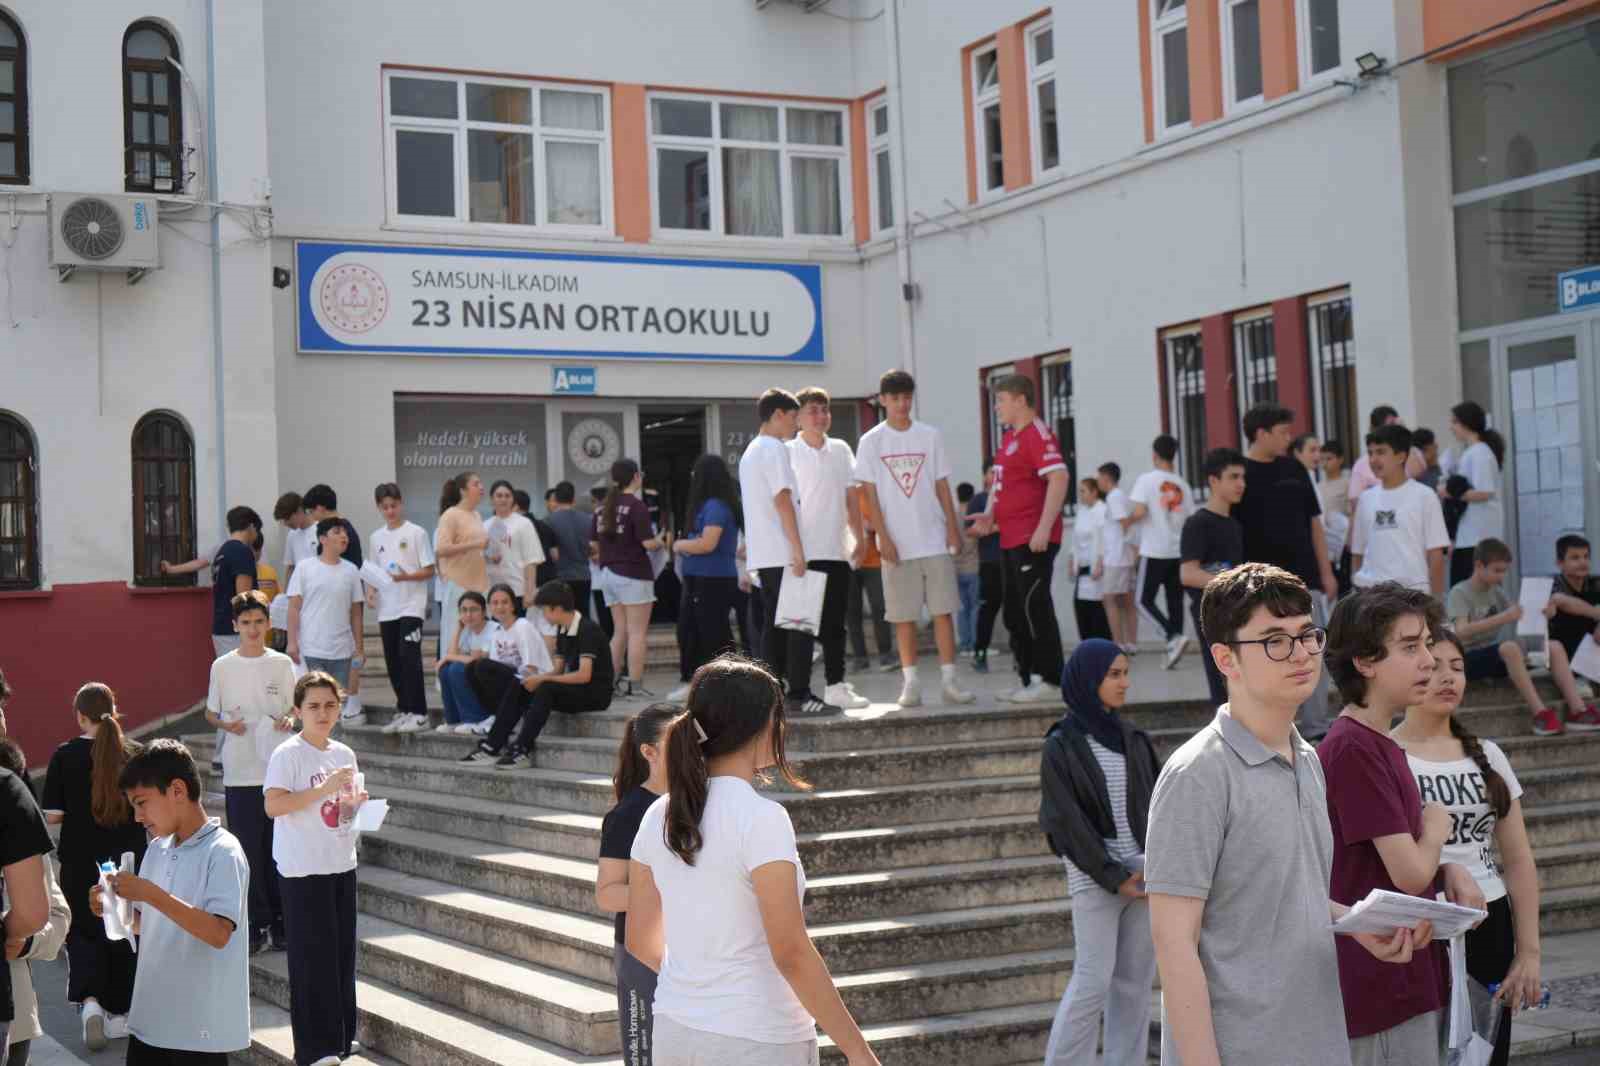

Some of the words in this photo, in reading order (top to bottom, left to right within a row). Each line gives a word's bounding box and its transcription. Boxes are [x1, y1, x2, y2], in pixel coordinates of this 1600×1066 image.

[412, 269, 579, 293] SAMSUN-İLKADIM
[1563, 278, 1578, 306] B
[1578, 280, 1600, 297] BLO
[411, 299, 451, 327] 23
[462, 293, 565, 330] NİSAN
[575, 303, 770, 337] ORTAOKULU
[554, 369, 569, 389] A
[473, 431, 528, 448] yüksek
[1418, 771, 1488, 805] ROKE
